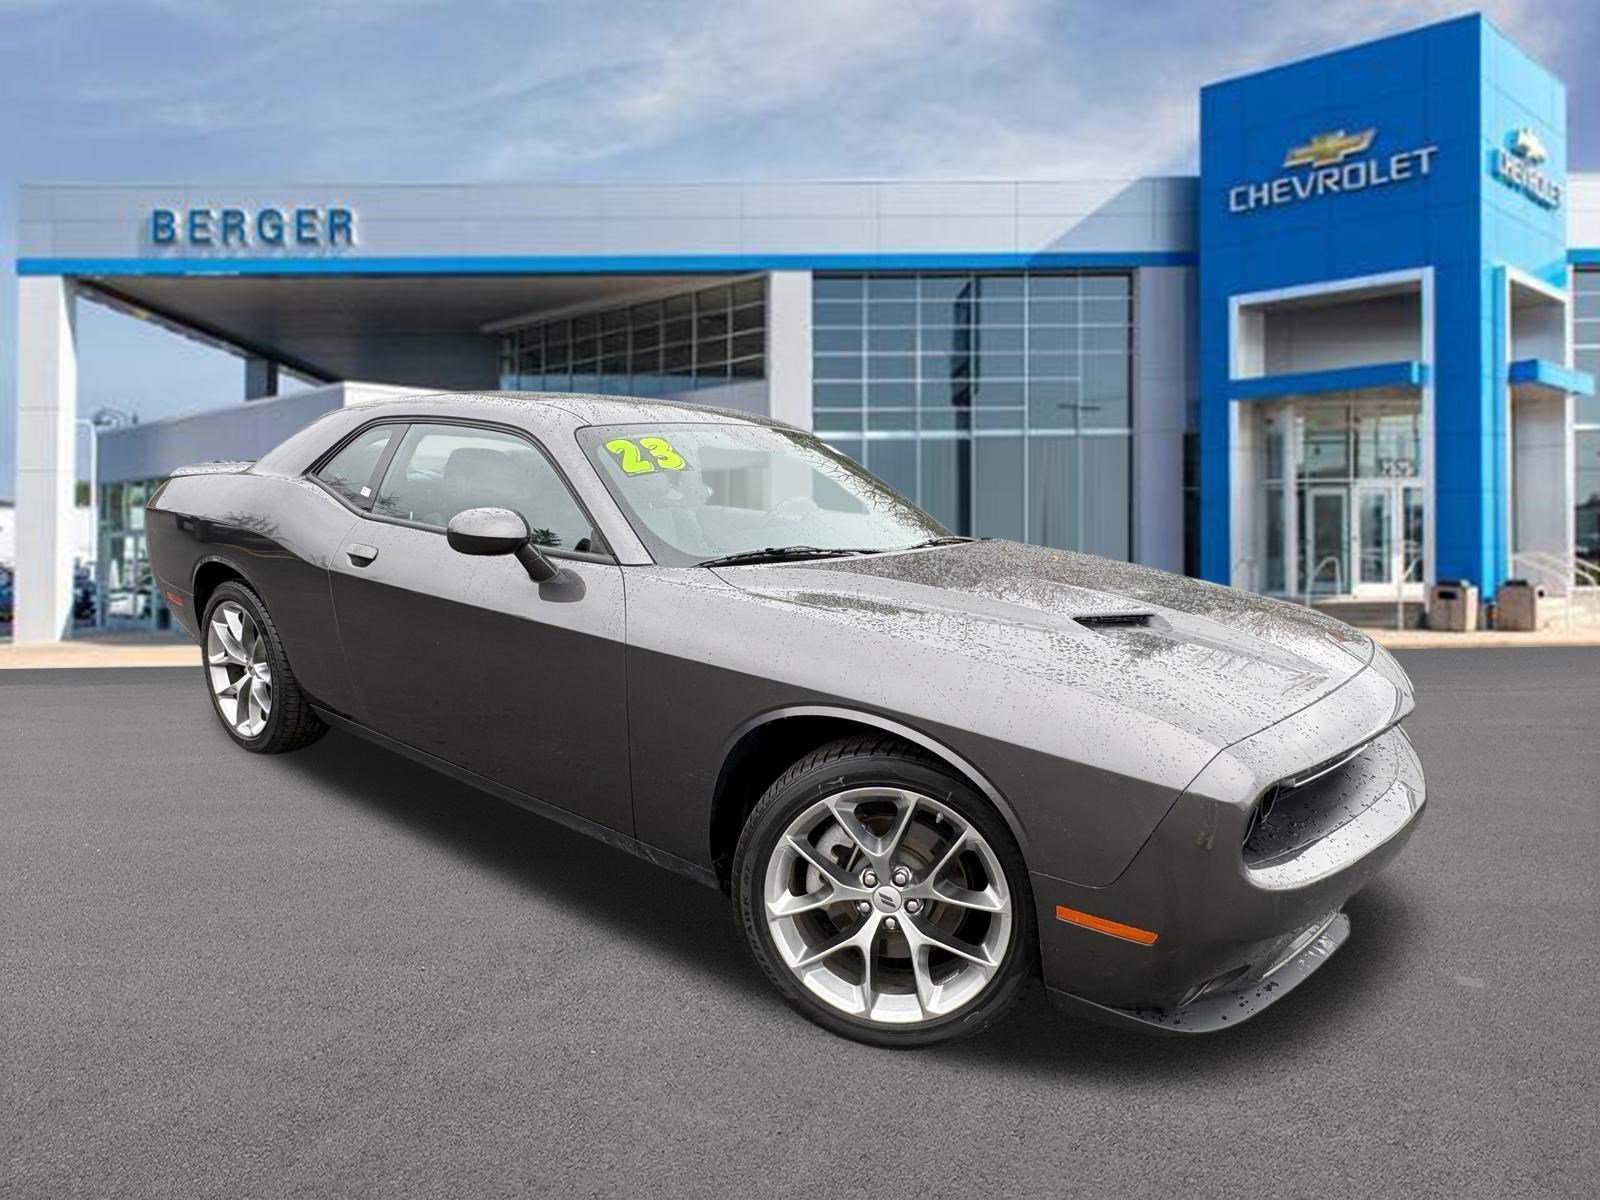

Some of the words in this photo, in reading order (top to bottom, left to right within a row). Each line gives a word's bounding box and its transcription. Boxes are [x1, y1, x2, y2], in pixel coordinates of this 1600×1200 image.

[1229, 146, 1437, 213] CHEVROLET
[152, 208, 354, 245] BERGER
[605, 436, 686, 475] 23
